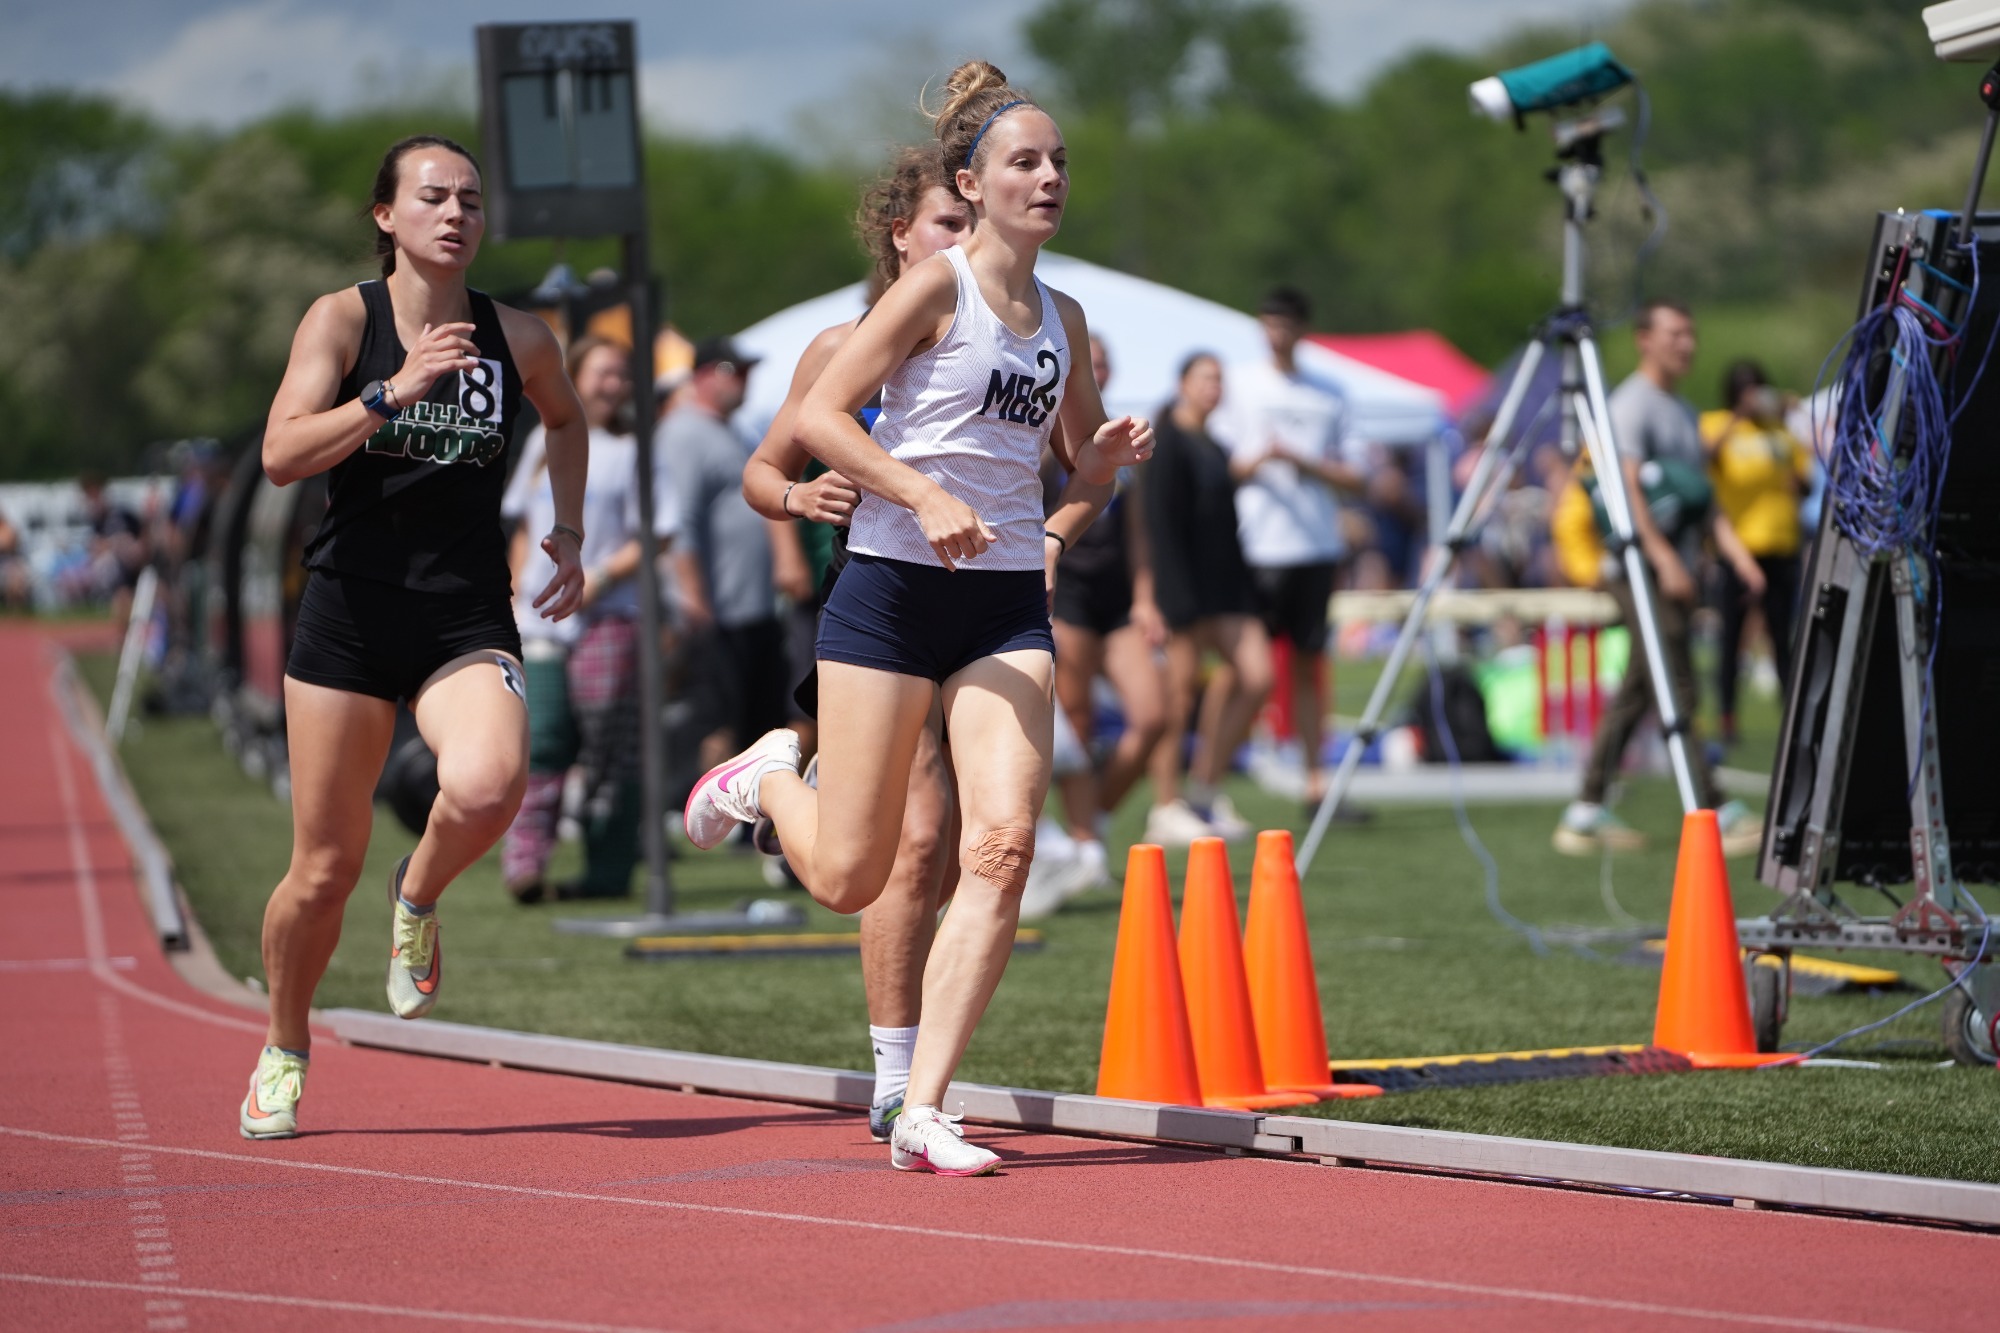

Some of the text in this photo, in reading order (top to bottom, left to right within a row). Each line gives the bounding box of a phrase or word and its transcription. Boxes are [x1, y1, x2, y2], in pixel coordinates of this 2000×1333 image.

[461, 359, 496, 419] 8
[1031, 350, 1061, 413] 2
[397, 401, 498, 432] ILLI
[365, 421, 505, 467] WOODS
